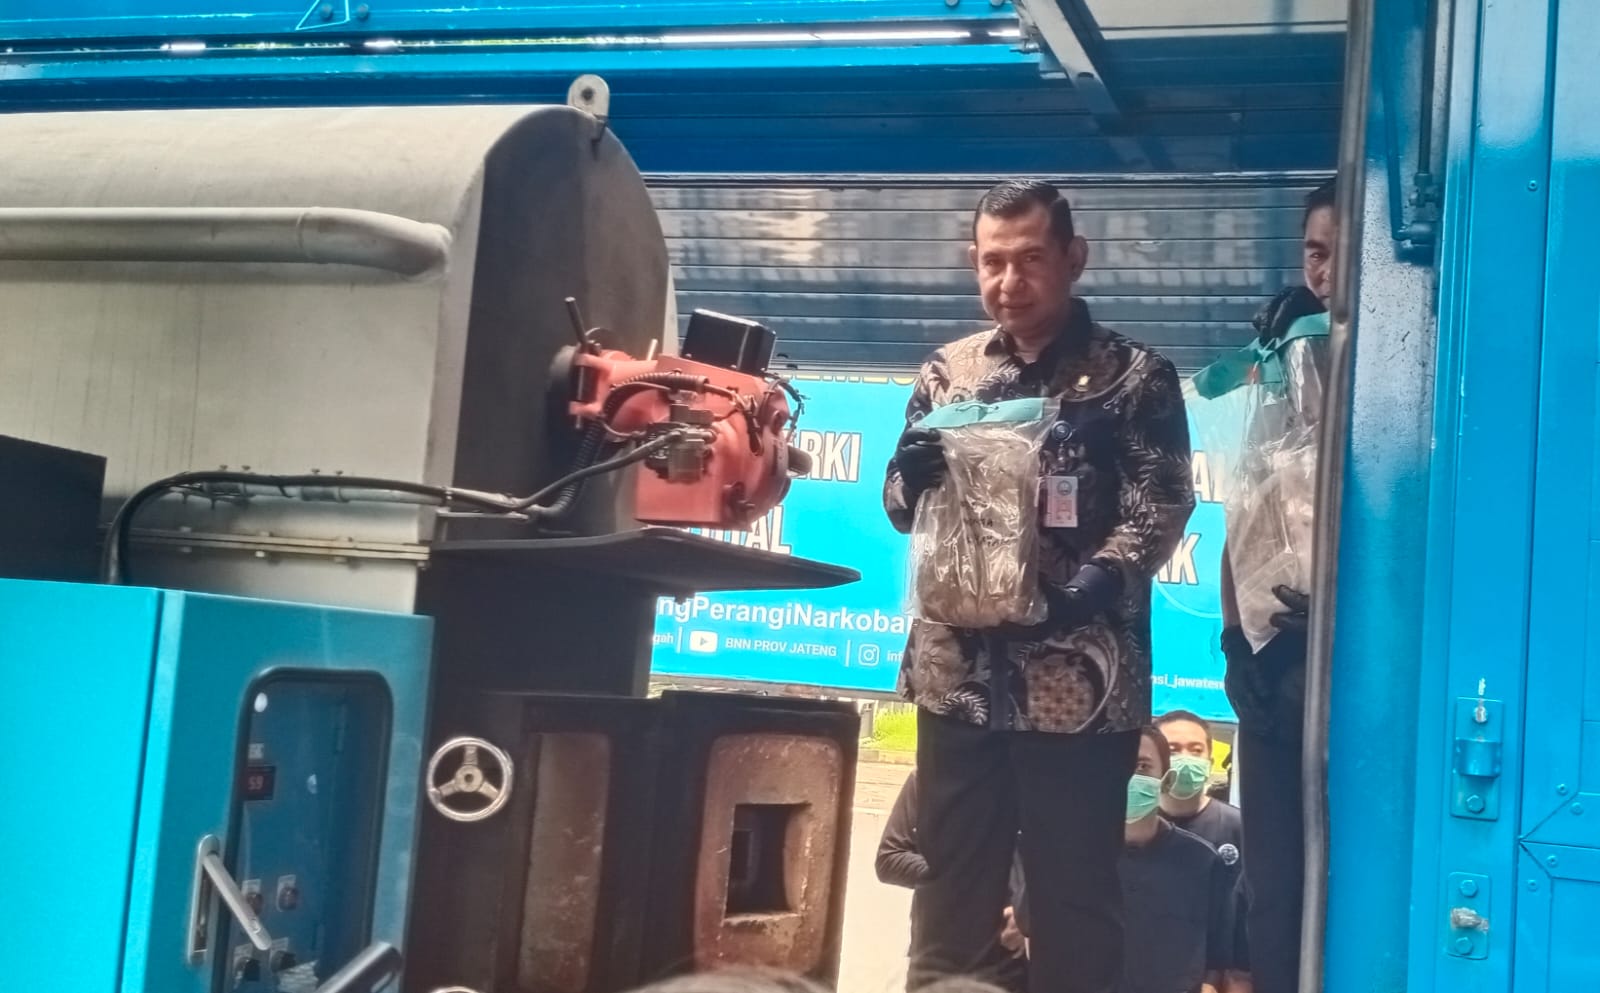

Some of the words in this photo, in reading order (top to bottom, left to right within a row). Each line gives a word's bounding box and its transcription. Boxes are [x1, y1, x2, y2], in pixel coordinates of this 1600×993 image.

[725, 636, 751, 650] BNN
[753, 639, 787, 653] PROV
[789, 643, 837, 657] JATENG
